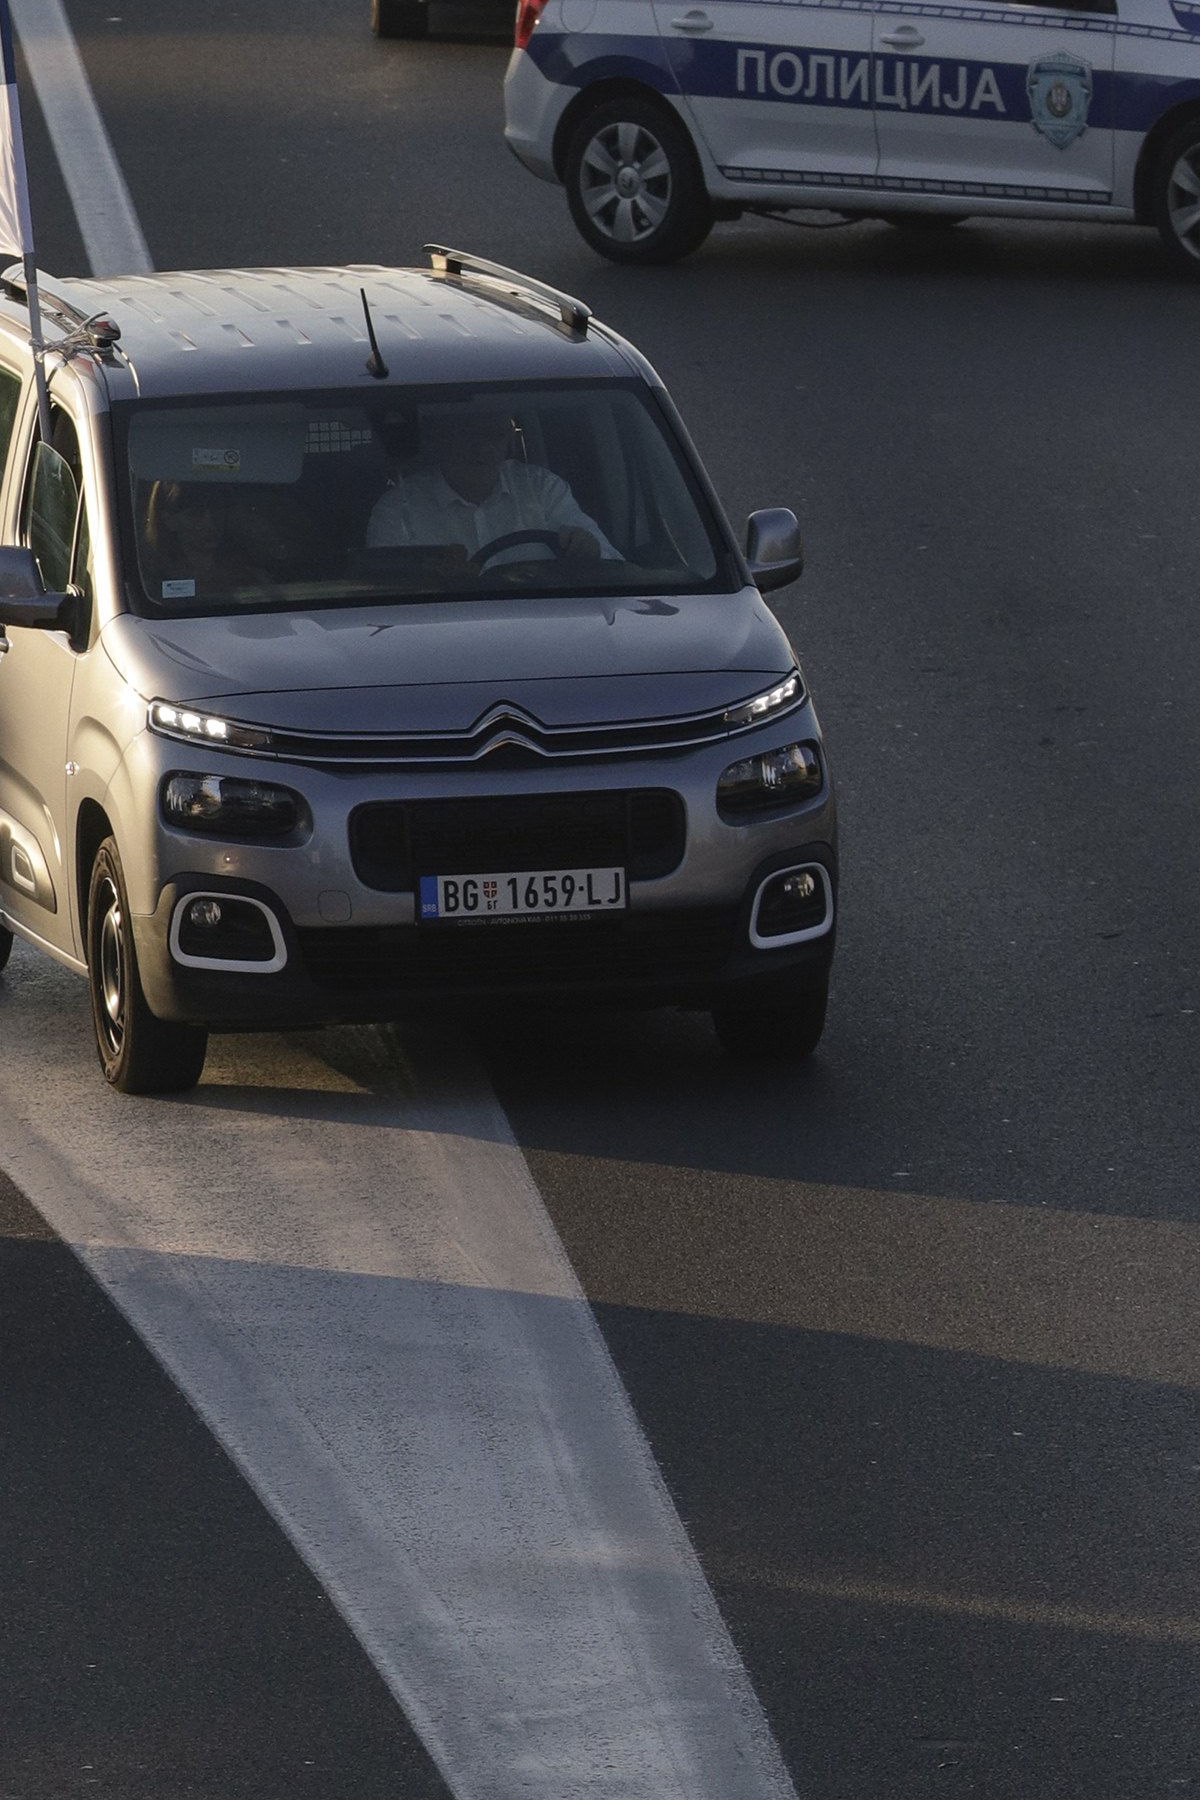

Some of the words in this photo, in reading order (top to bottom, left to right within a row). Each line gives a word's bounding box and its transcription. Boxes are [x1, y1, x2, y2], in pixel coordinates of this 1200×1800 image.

[736, 49, 1006, 112] ПОЛИЦИЈА
[422, 903, 438, 913] SRB
[443, 879, 479, 913] BG
